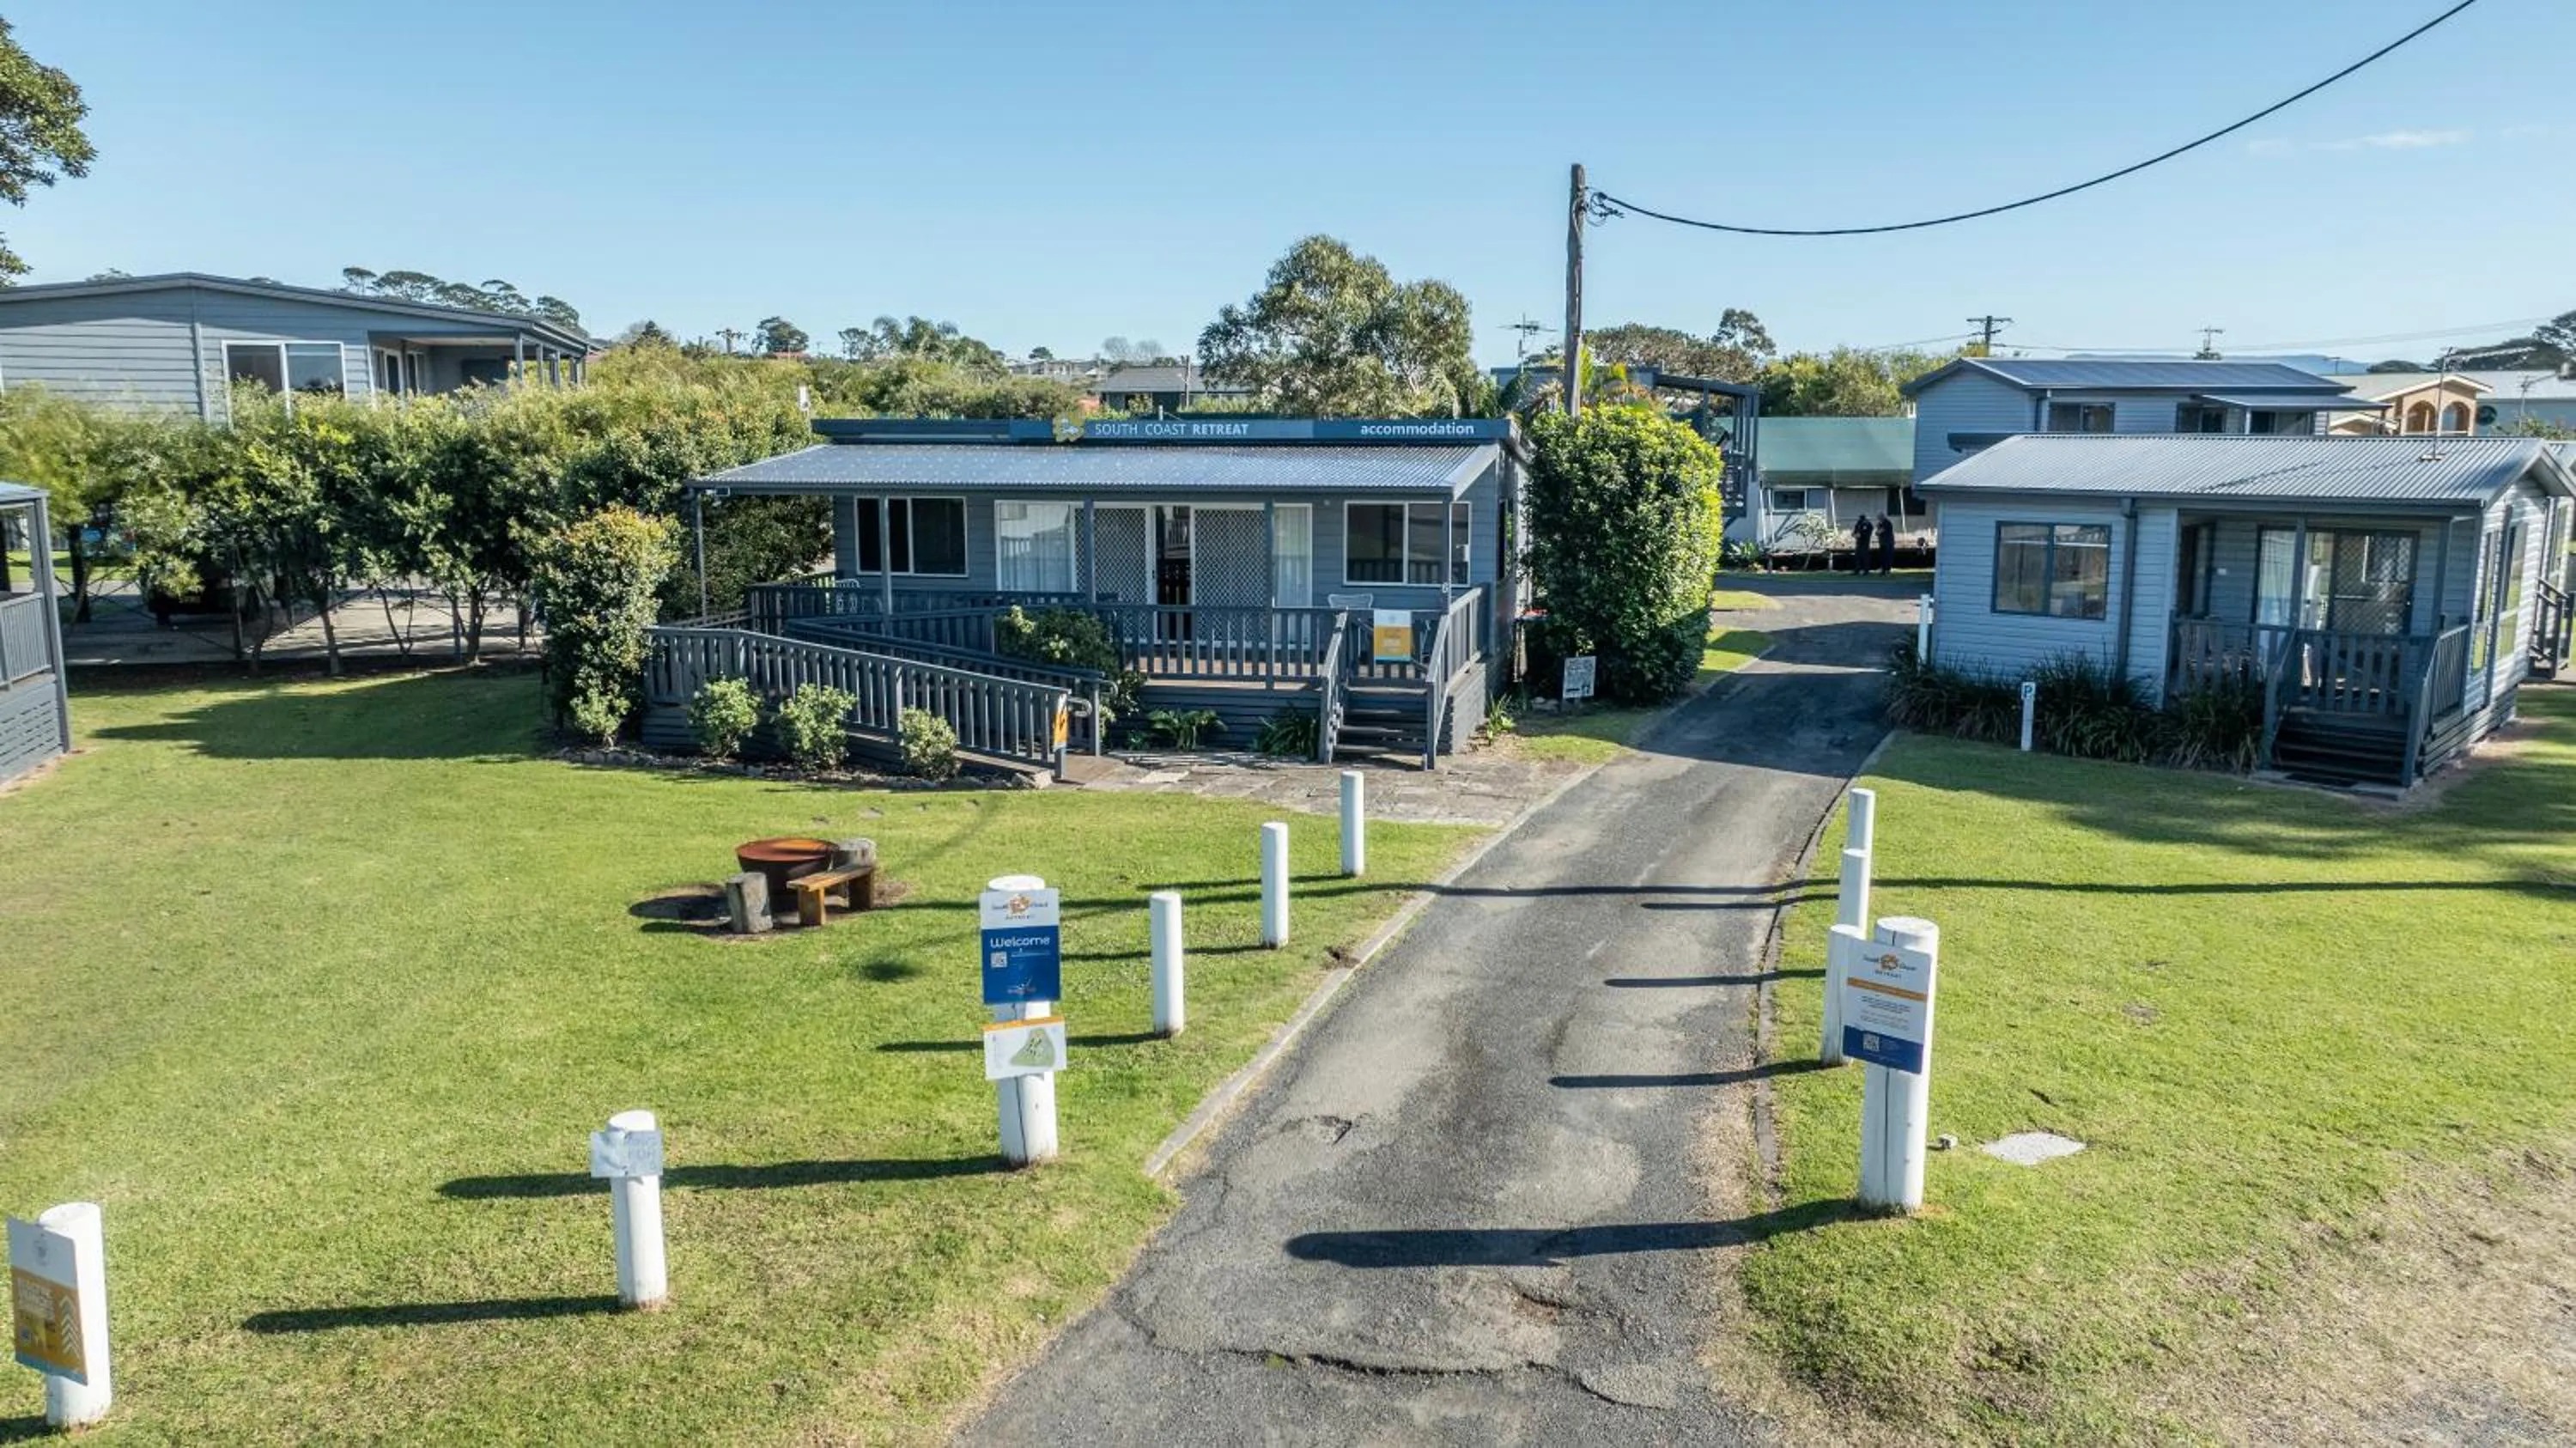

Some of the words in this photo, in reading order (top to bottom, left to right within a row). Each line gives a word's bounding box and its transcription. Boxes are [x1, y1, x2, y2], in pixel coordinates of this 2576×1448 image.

[1095, 423, 1138, 435] SOUTH
[1145, 423, 1187, 435] COAST
[1193, 423, 1249, 435] RETREAT
[1360, 422, 1475, 435] accommodation
[990, 936, 1050, 948] Welcome
